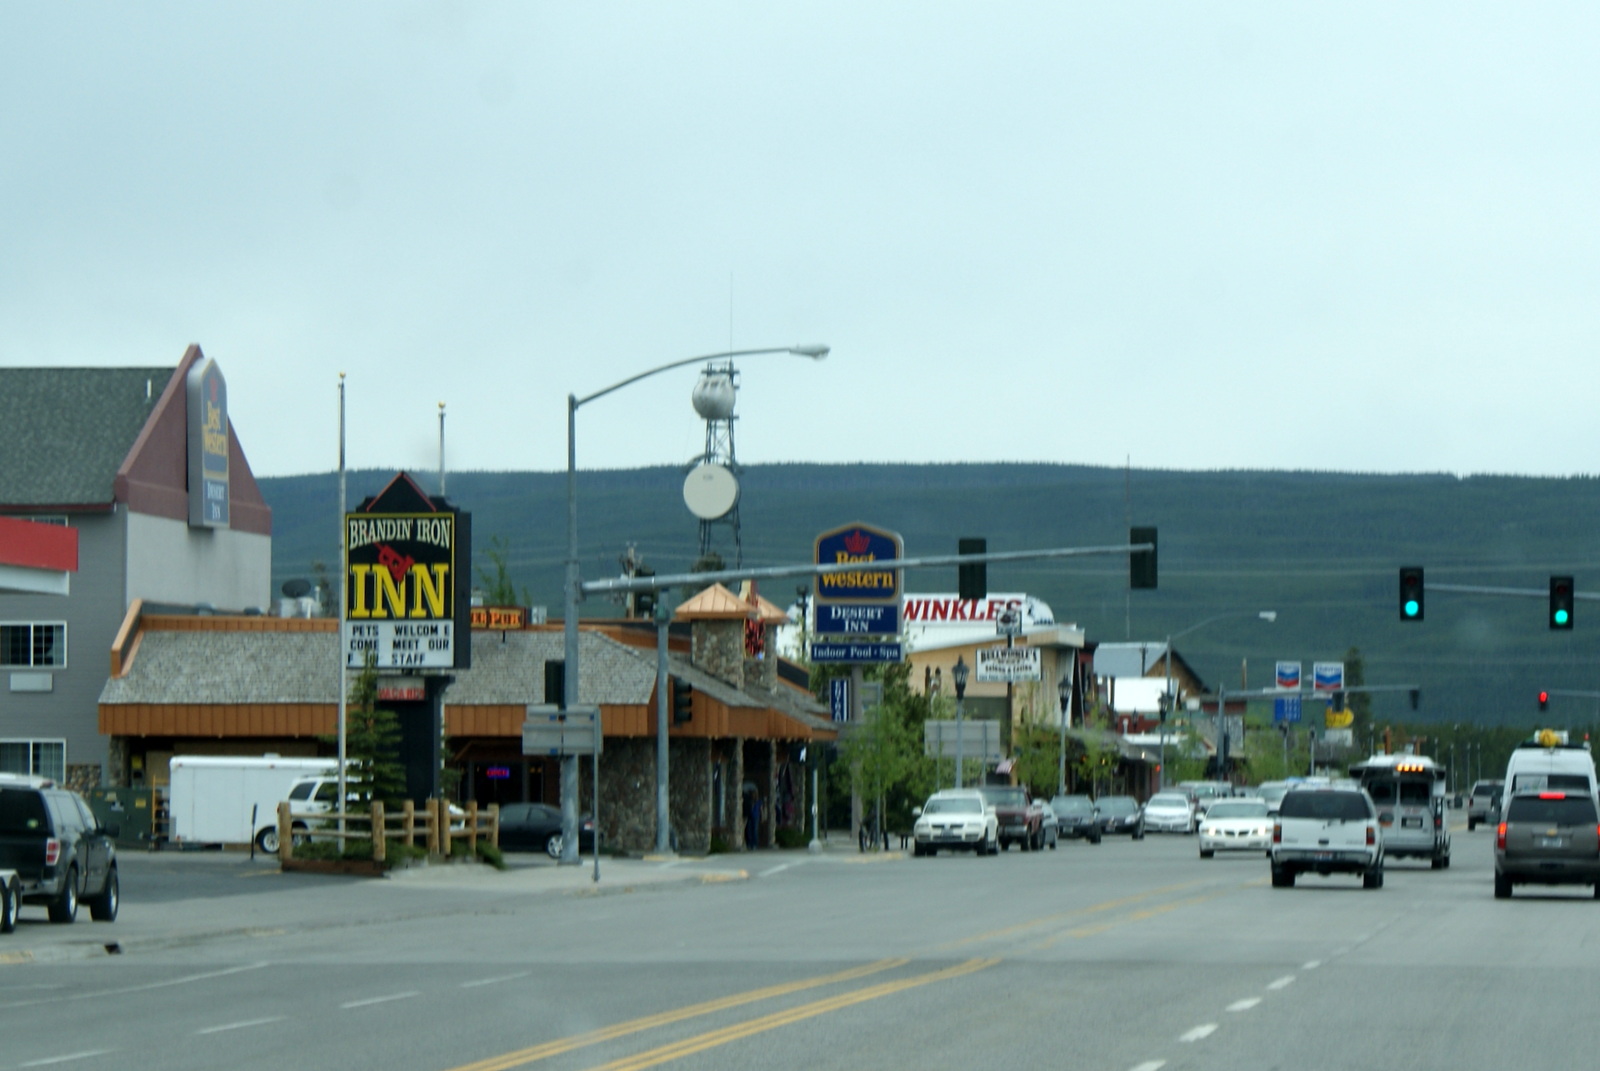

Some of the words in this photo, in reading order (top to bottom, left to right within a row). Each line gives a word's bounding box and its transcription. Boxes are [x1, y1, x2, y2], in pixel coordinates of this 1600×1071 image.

[349, 519, 414, 550] BRANDIN'
[416, 519, 451, 549] IRON
[349, 563, 449, 619] INN
[352, 624, 379, 636] PETS
[844, 620, 869, 633] INN
[350, 640, 378, 651] COME
[392, 640, 419, 651] MEET
[428, 640, 449, 651] OUR
[850, 645, 872, 658] Pool
[880, 645, 898, 659] Spa
[391, 653, 425, 665] STAFF
